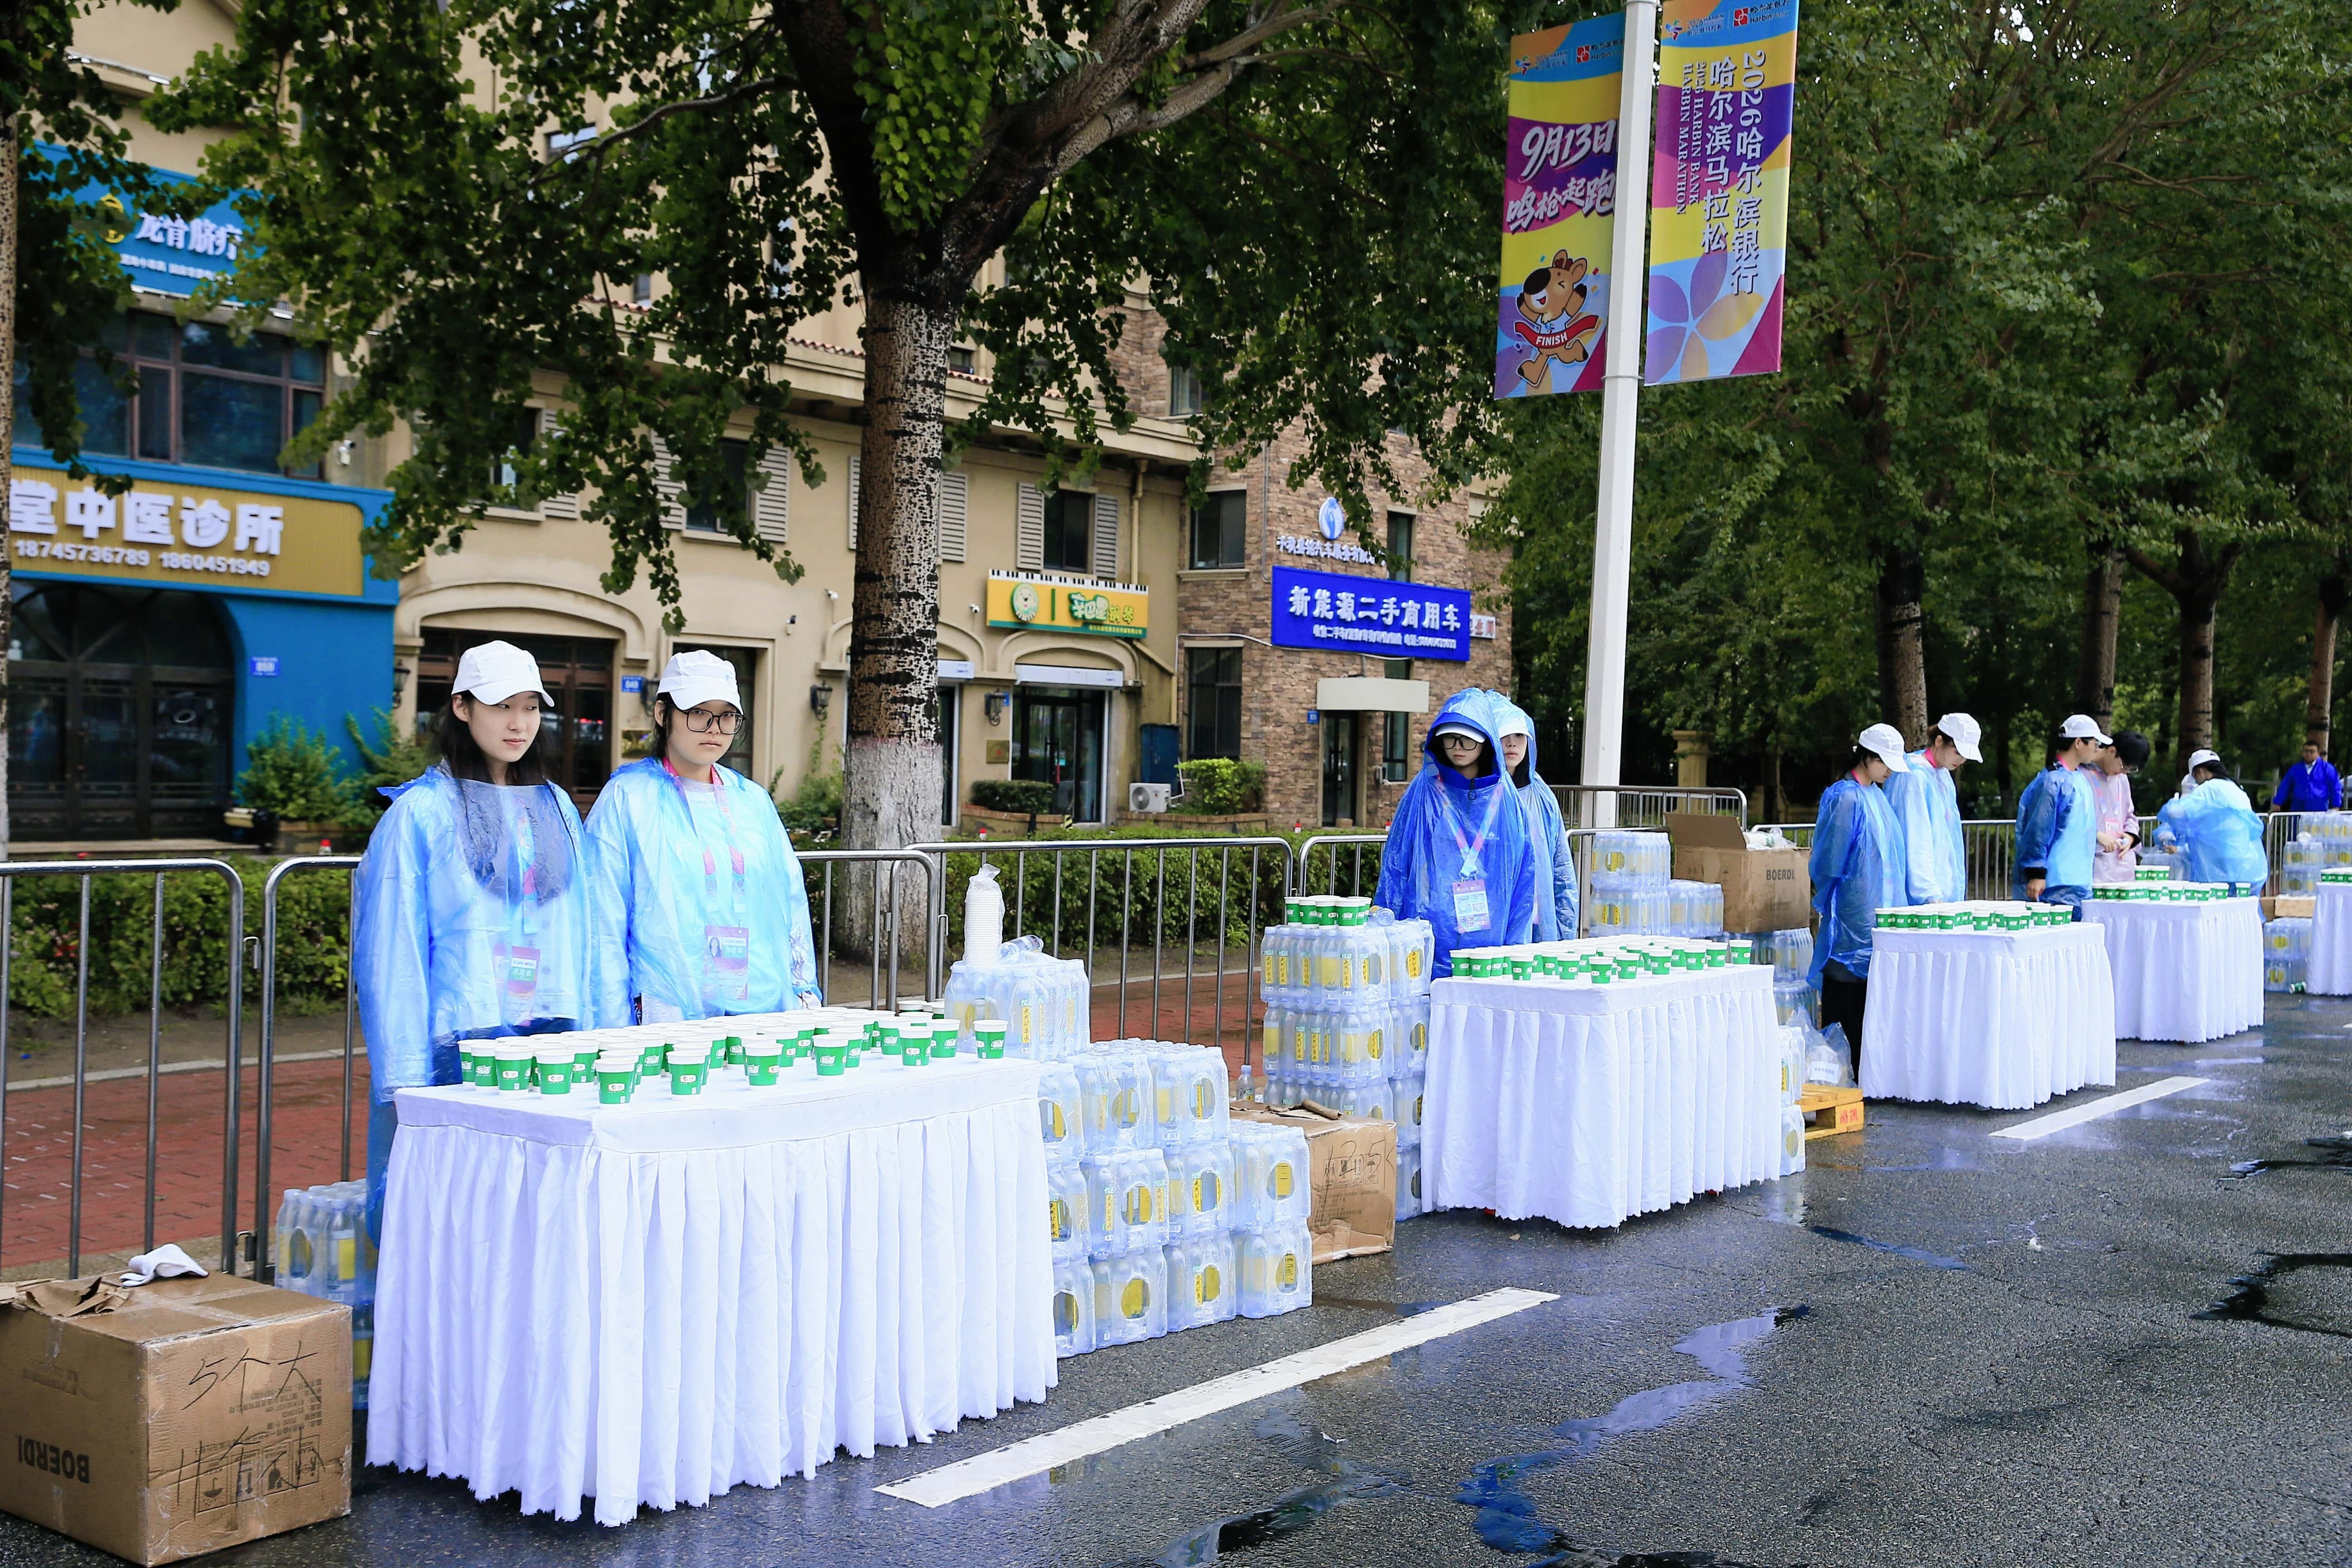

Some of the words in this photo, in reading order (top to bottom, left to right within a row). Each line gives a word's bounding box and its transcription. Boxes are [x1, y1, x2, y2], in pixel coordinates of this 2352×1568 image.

[1681, 63, 1693, 122] HARBIN
[1695, 61, 1706, 94] 2026
[1518, 119, 1616, 183] 9月13日
[1691, 97, 1704, 157] HARBIN
[1701, 55, 1737, 254] 哈尔滨马拉松
[1506, 168, 1616, 231] 鸣枪起跑
[1676, 127, 1690, 215] MARATHON
[1689, 161, 1700, 206] BANK
[1730, 49, 1766, 295] 2026哈尔滨银行
[1536, 332, 1568, 346] FINISH
[15, 539, 151, 567] 18745736789
[1289, 585, 1461, 632] 新能源二手商用车
[1470, 618, 1494, 636] 生间
[182, 1341, 322, 1415] 5个大
[18, 1435, 90, 1484] BOERDI
